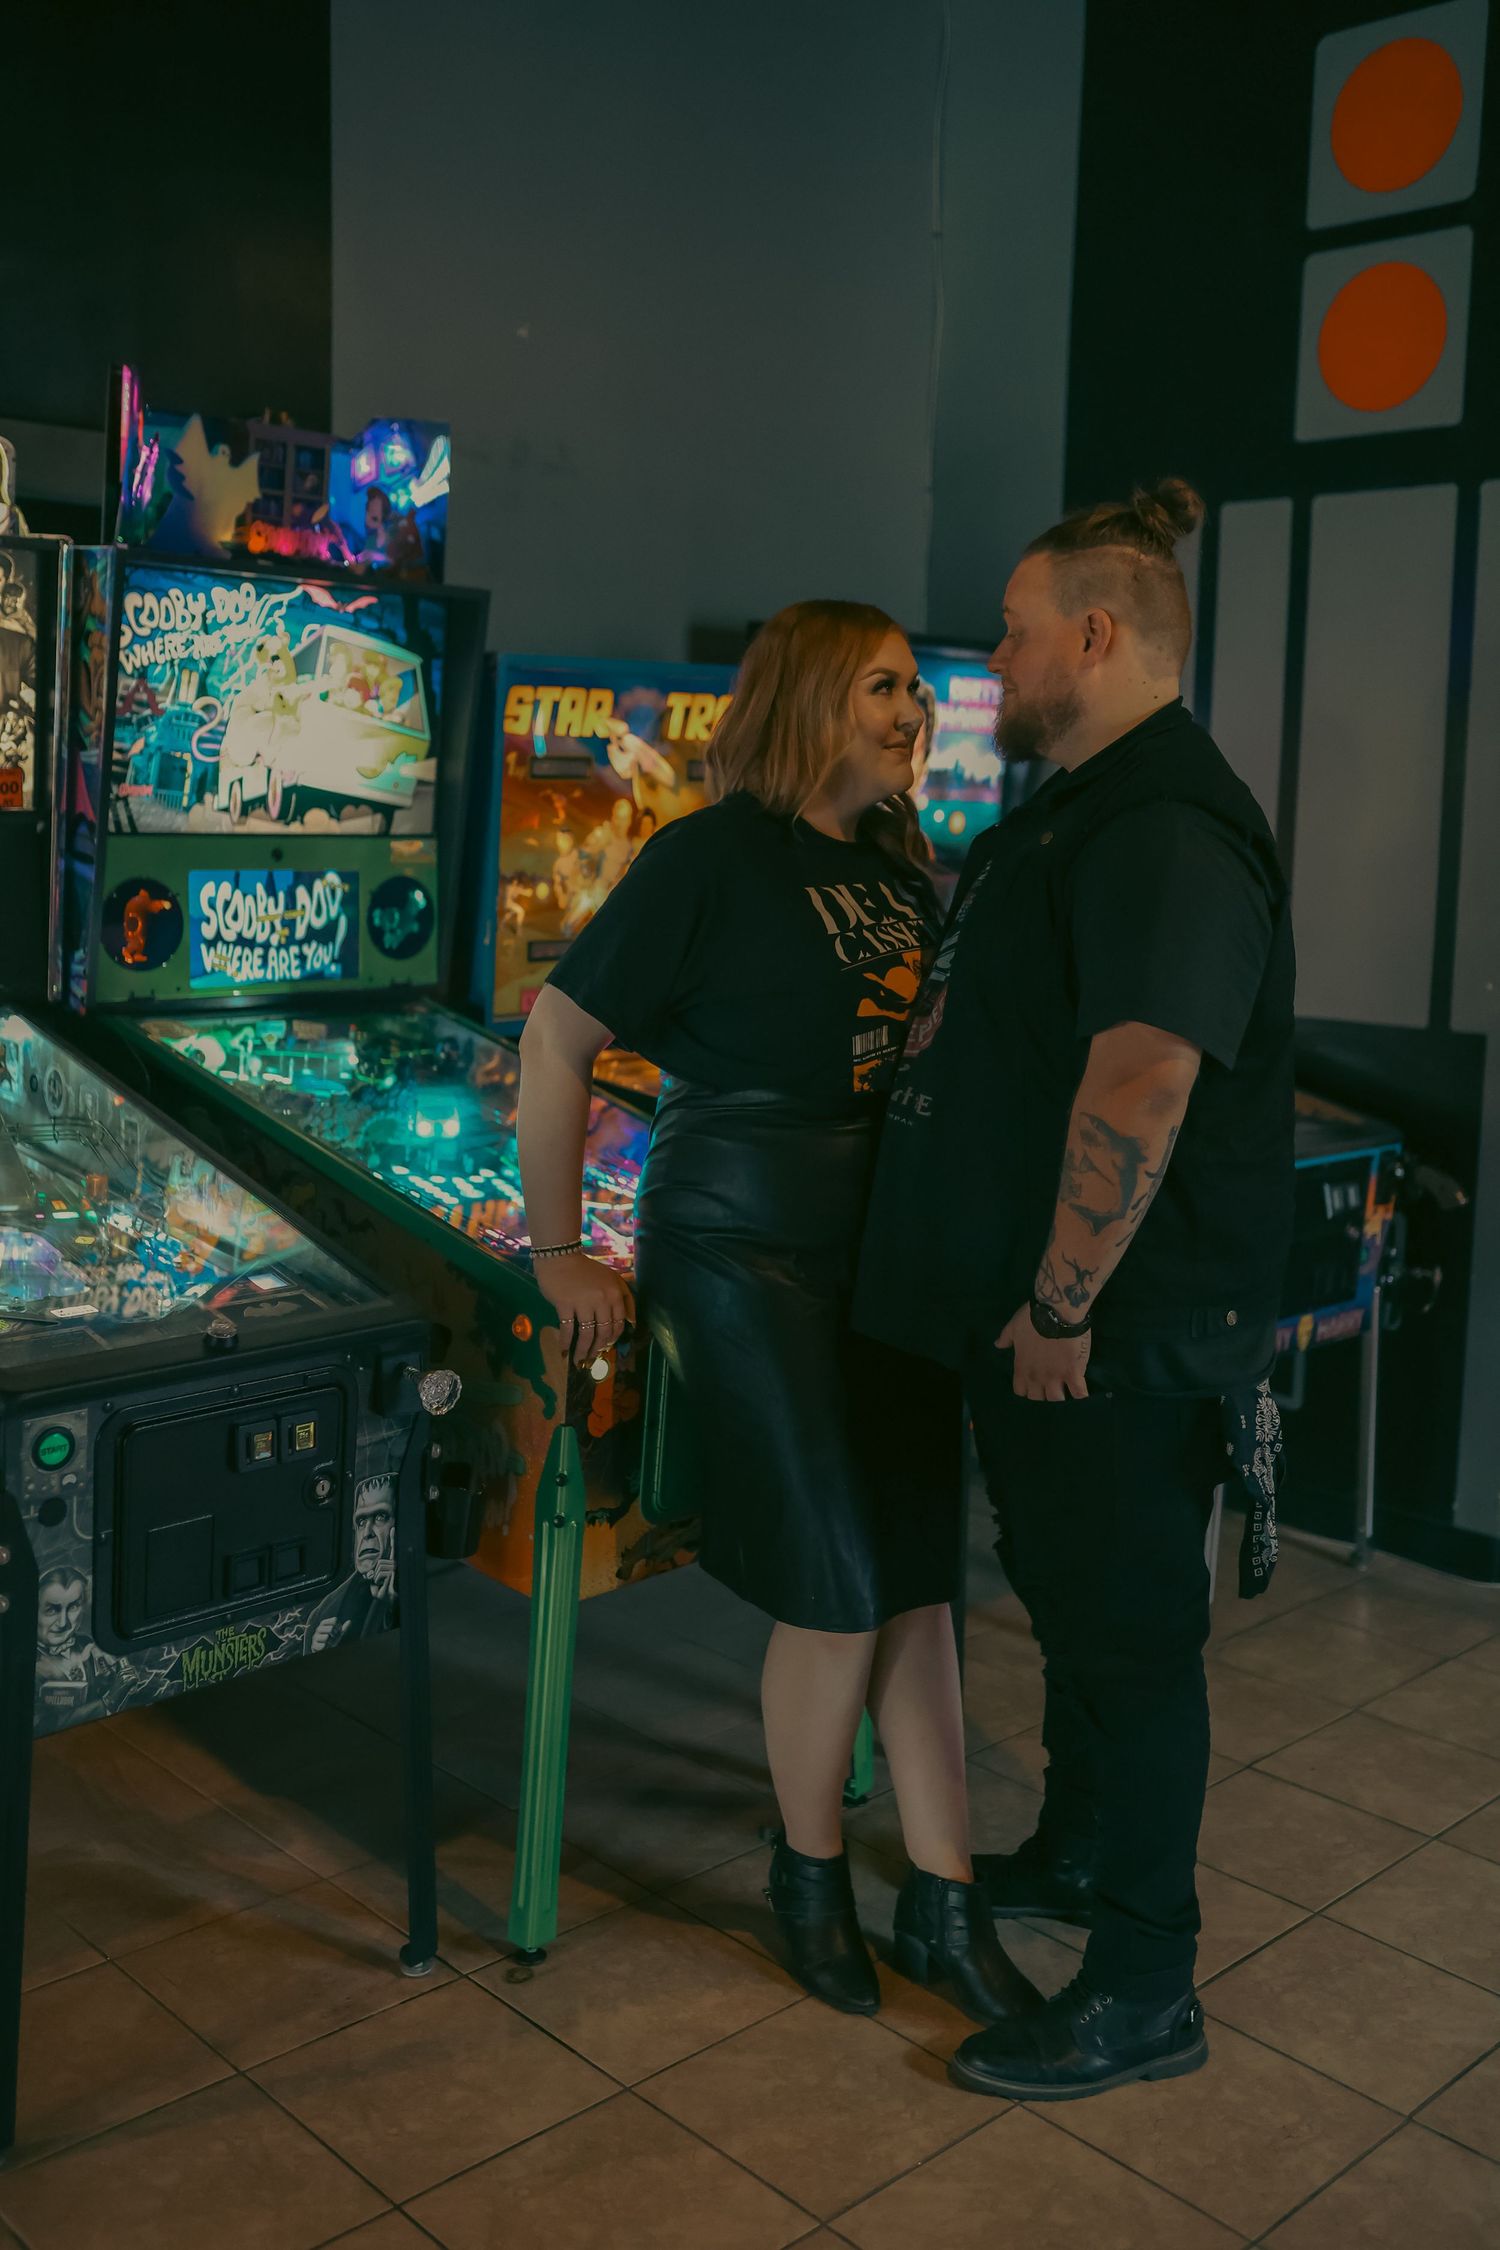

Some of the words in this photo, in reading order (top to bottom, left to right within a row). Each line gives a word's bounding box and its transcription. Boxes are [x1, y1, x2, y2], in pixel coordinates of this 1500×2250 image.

[119, 632, 191, 675] WHERE
[503, 685, 615, 738] STAR
[200, 940, 264, 983] WHERE
[266, 944, 301, 983] ARE
[215, 1626, 235, 1641] THE
[182, 1627, 267, 1692] MUNSTERS
